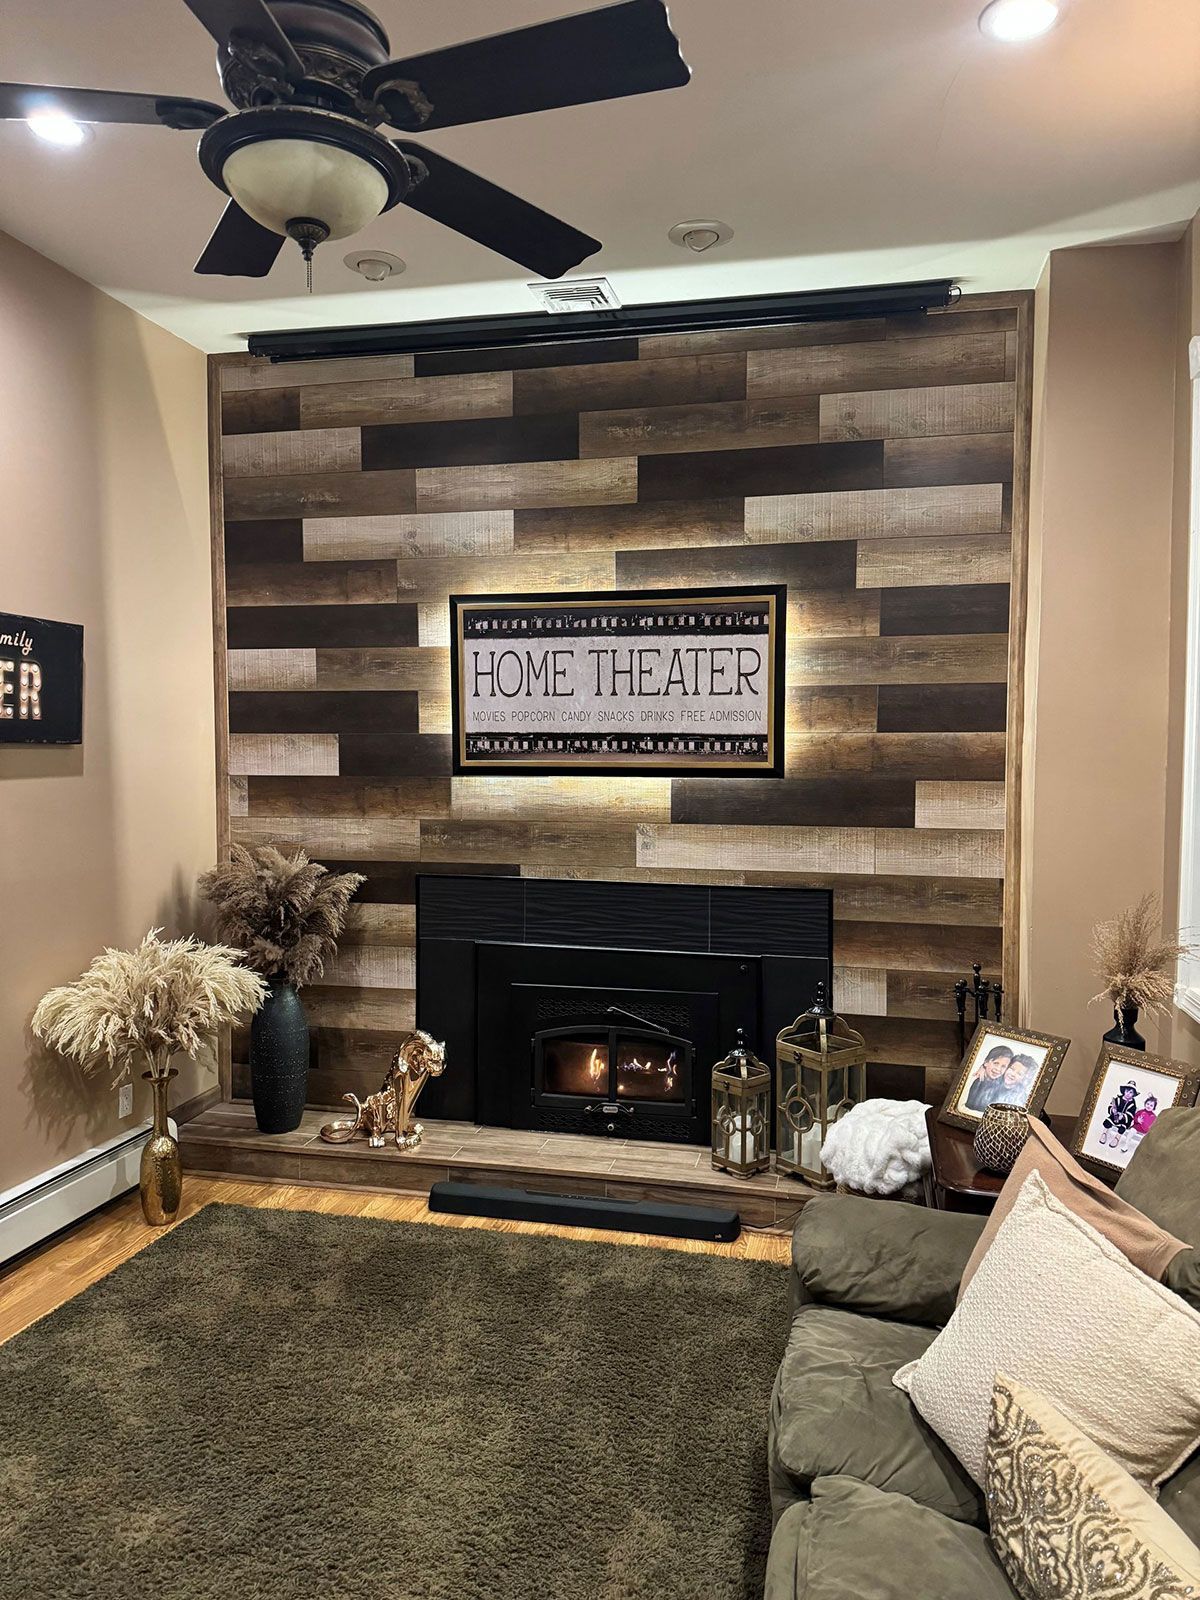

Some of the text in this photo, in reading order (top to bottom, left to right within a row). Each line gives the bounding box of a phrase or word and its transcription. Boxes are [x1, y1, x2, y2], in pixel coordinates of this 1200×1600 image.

[472, 647, 762, 698] HOME THEATER
[472, 710, 762, 722] MOVIES POPCORN CANDY SNACKS DRINKS FREE ADMISSION
